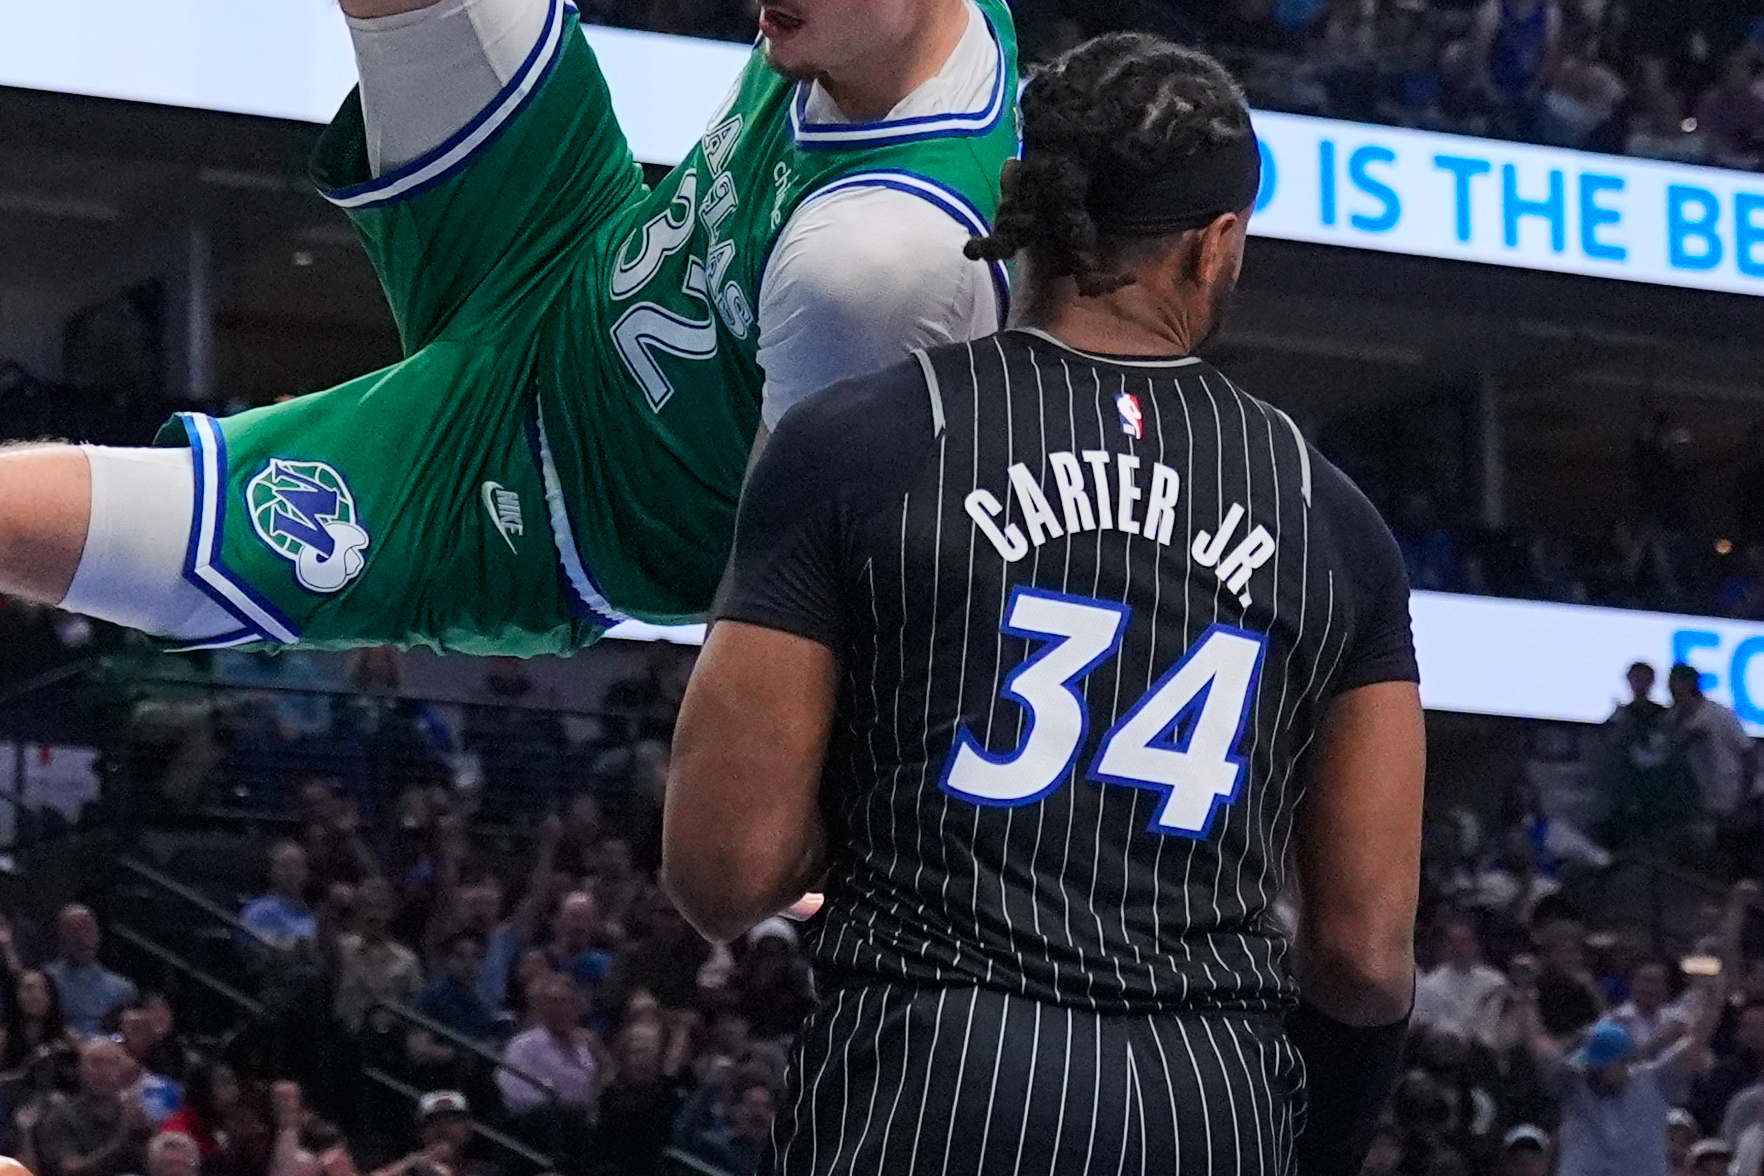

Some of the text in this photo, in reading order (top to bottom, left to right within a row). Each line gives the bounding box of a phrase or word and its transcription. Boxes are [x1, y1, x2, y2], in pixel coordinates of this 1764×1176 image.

[1319, 139, 1403, 232] IS
[1433, 155, 1627, 261] THE
[1667, 184, 1764, 277] BE
[609, 168, 718, 414] 32
[495, 489, 525, 537] NIKE
[964, 450, 1276, 609] CARTER JR.
[939, 584, 1269, 840] 34
